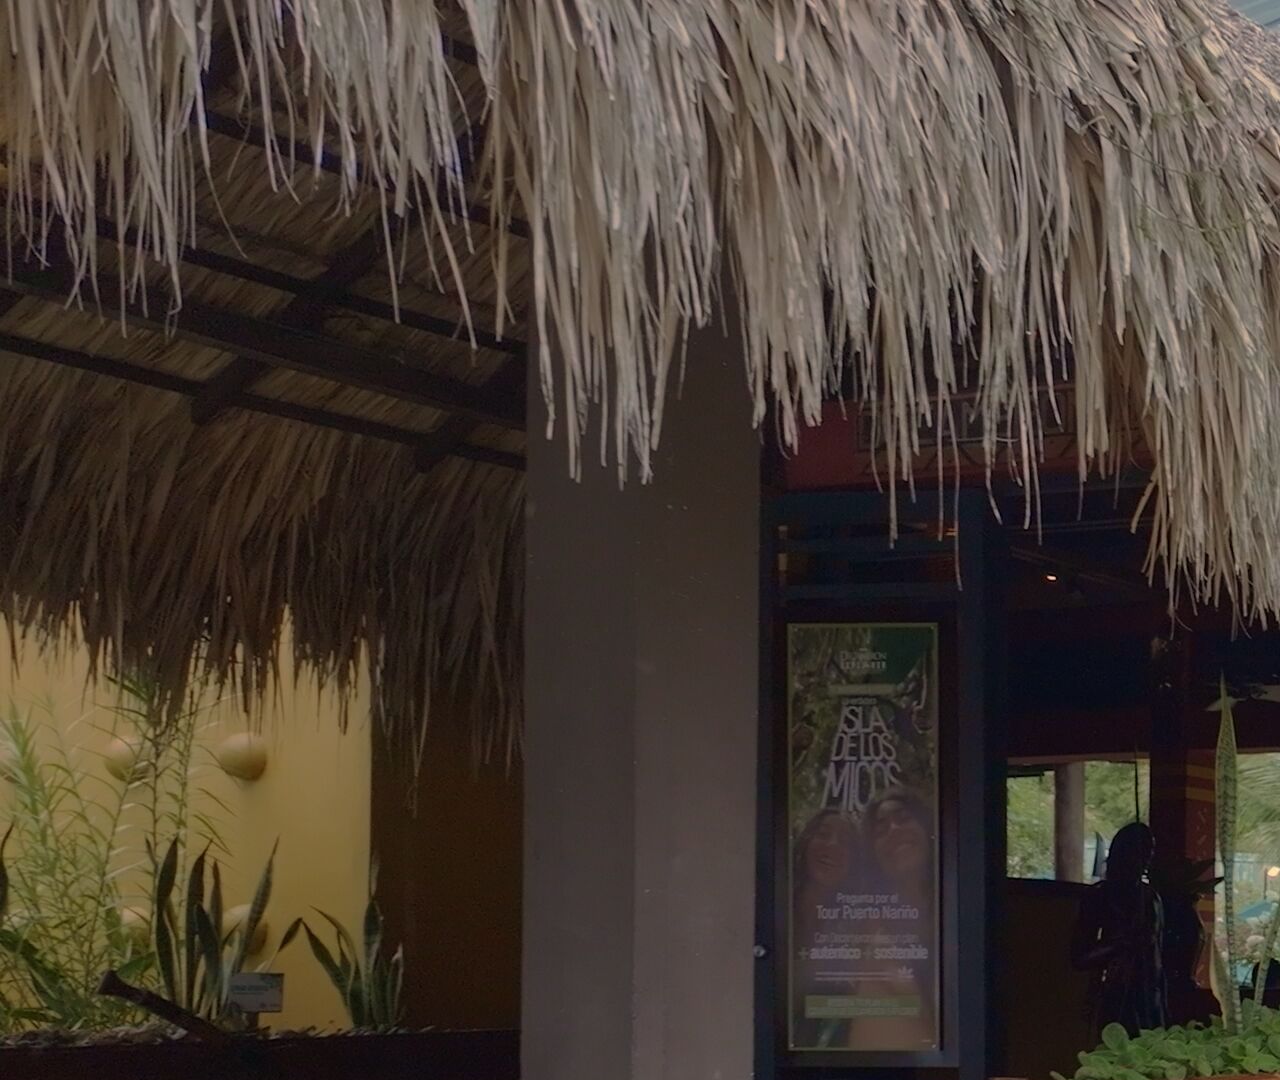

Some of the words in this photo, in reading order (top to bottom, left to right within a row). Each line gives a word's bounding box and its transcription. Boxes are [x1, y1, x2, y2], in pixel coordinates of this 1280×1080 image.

[838, 705, 889, 734] ISLA
[831, 732, 858, 762] DE
[859, 732, 897, 761] LOS
[836, 892, 874, 906] Pregunta
[875, 894, 889, 906] por
[890, 892, 899, 904] el
[816, 904, 841, 920] Tour
[842, 904, 881, 920] Puerto
[882, 904, 920, 920] Nariño
[809, 944, 862, 960] auténtico
[873, 944, 929, 960] sostenible
